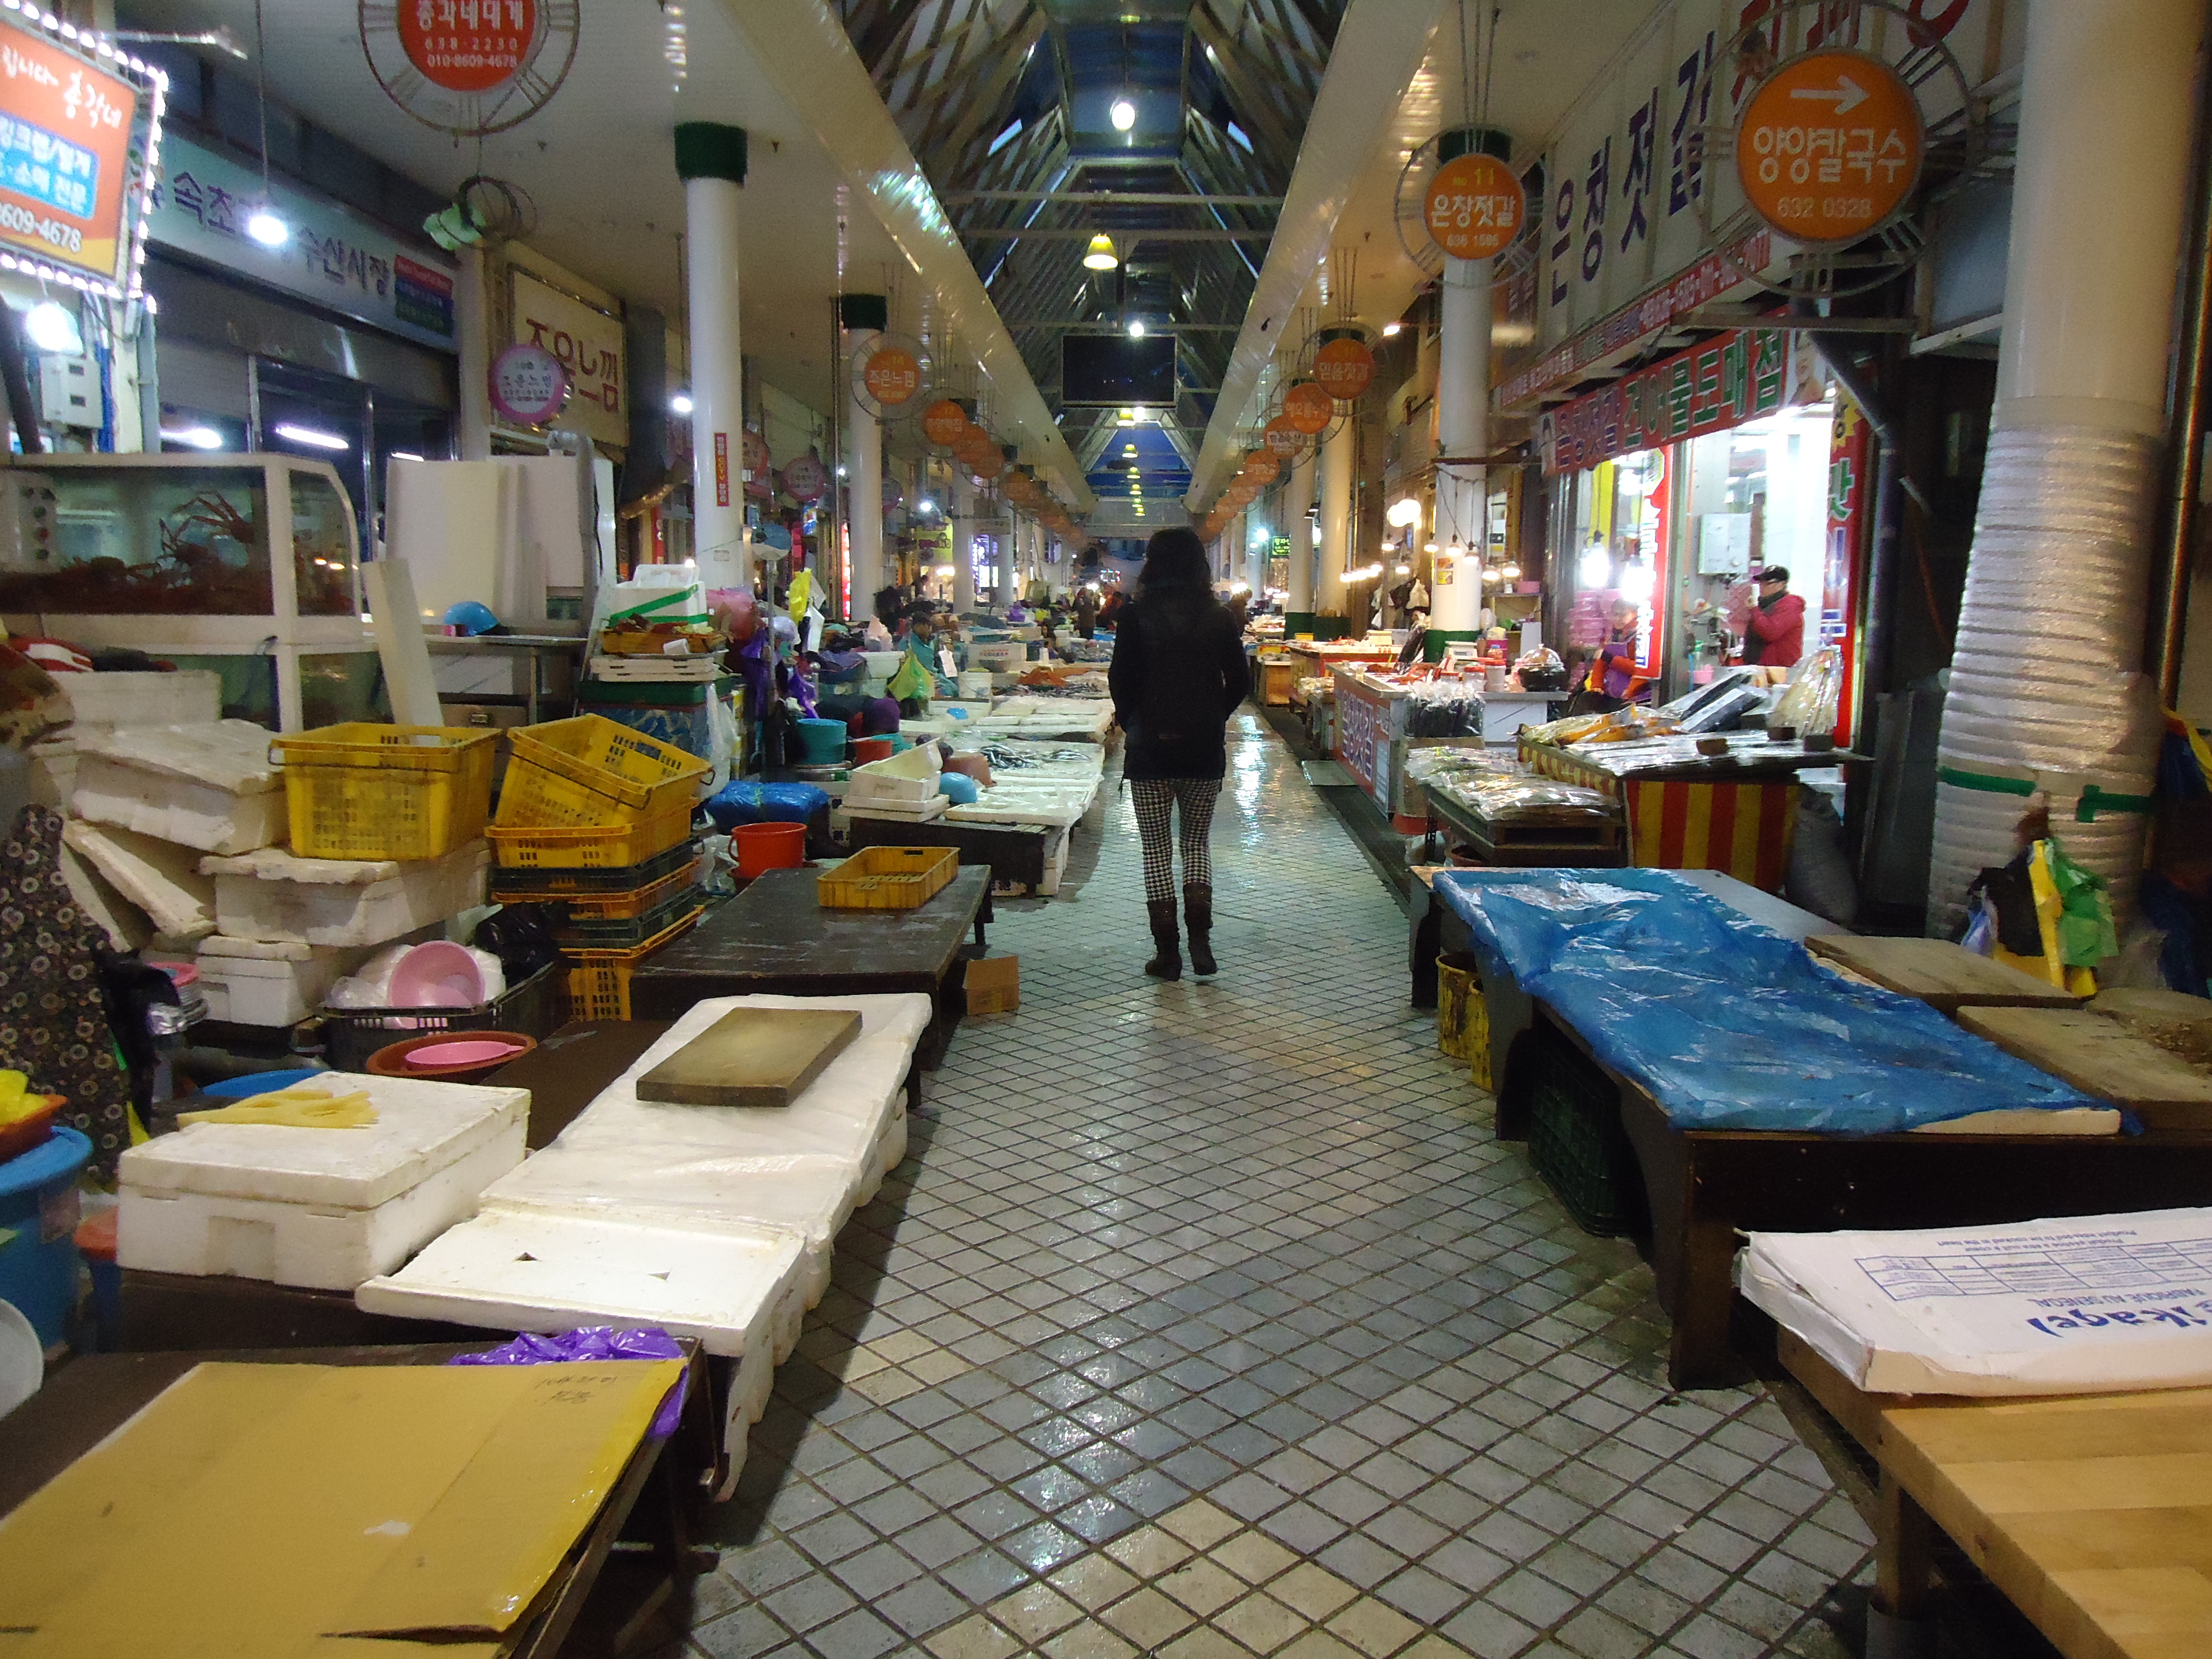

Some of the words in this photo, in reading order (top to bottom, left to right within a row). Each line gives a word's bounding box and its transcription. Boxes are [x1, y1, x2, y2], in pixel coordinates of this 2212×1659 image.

[1551, 30, 1714, 307] 은창젓갈
[1753, 126, 1906, 184] 양양칼국수
[1432, 194, 1516, 227] 은창젓갈
[2102, 1295, 2126, 1303] AU
